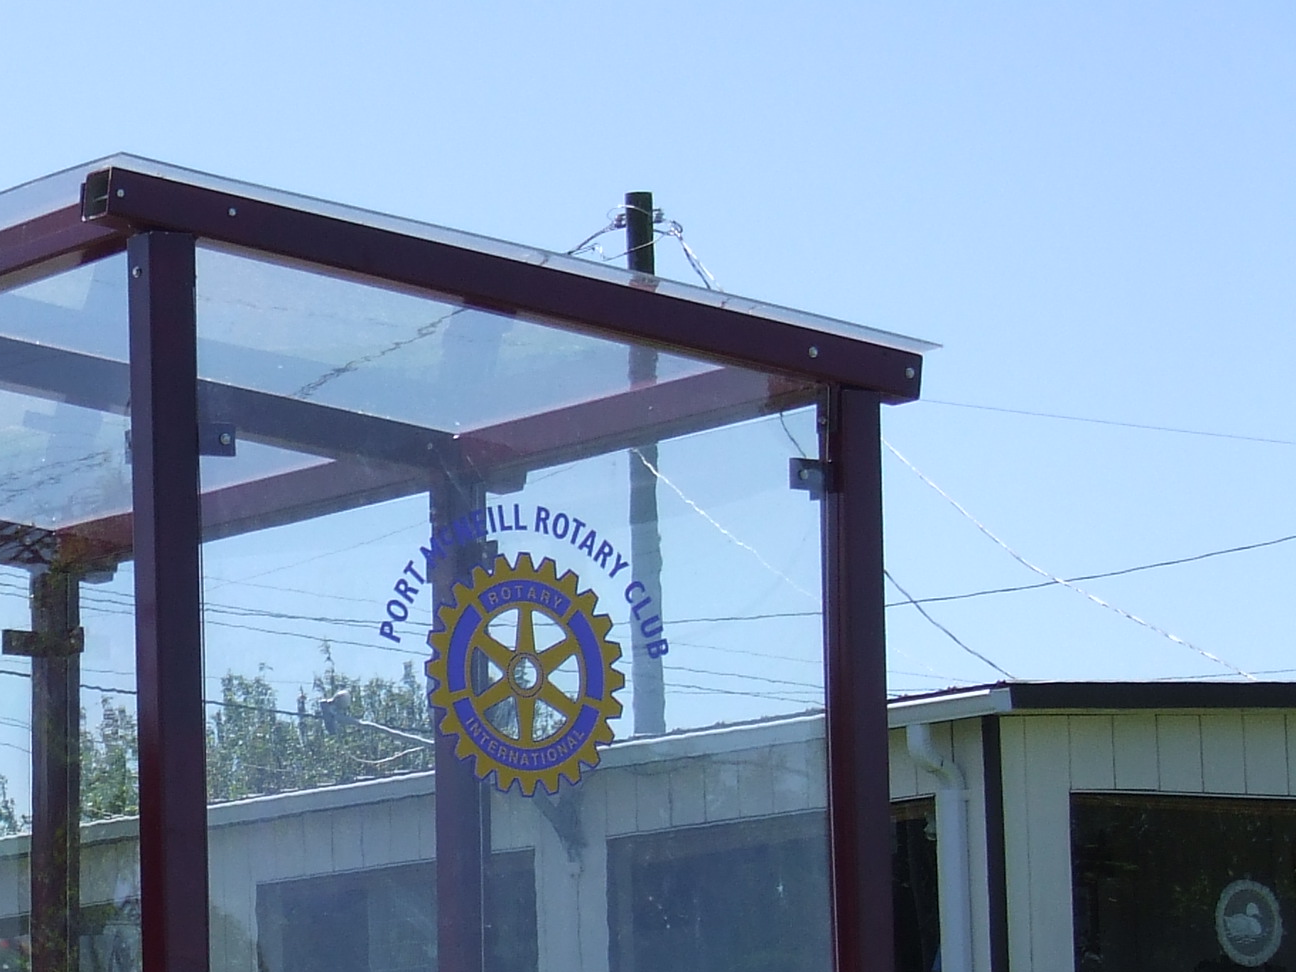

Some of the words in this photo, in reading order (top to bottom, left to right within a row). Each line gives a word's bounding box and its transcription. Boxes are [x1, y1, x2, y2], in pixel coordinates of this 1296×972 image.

[379, 560, 425, 643] PORT
[535, 506, 629, 578] ROTARY
[624, 581, 669, 659] CLUB
[487, 585, 563, 609] ROTARY
[465, 717, 585, 766] INTERNATIONAL
